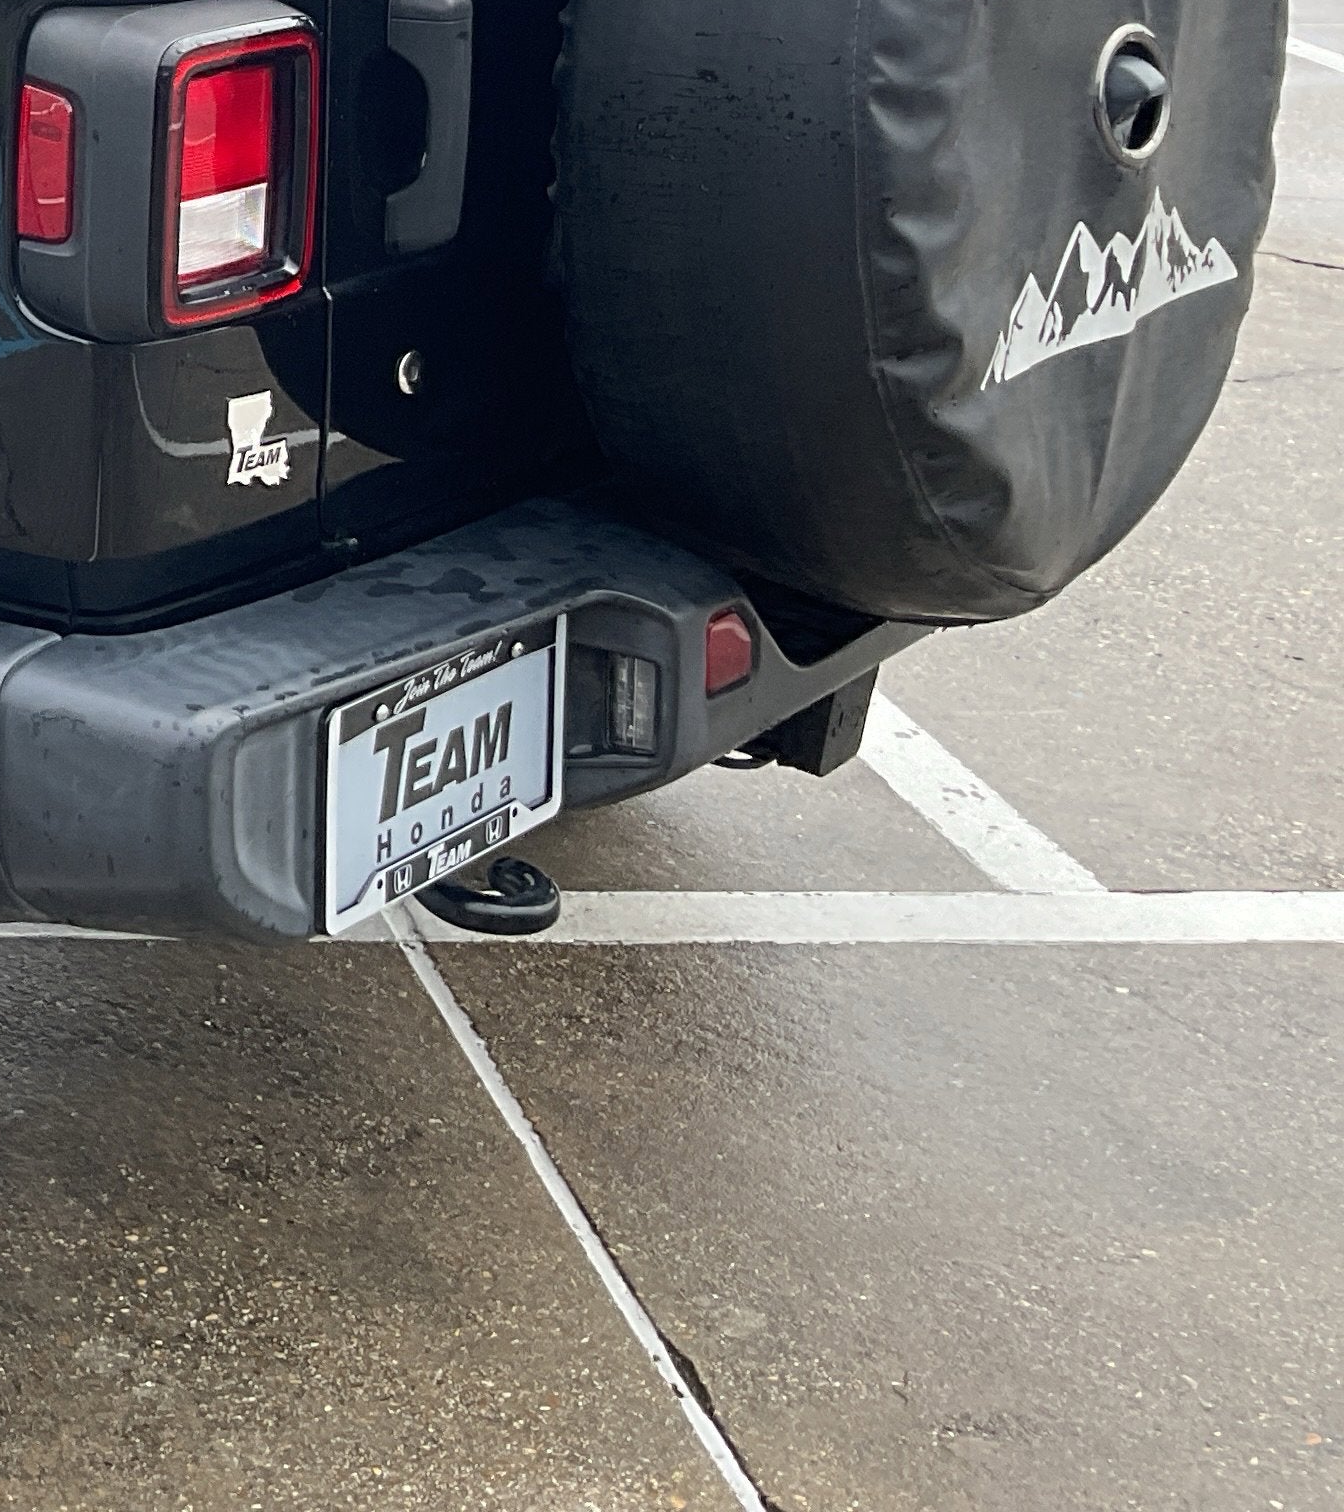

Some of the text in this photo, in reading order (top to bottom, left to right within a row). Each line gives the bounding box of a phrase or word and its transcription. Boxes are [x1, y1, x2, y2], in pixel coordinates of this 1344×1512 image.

[237, 445, 282, 474] TEAM
[393, 678, 431, 715] Join
[373, 701, 513, 825] TEAM
[377, 775, 512, 864] Honda
[427, 839, 472, 879] TEAM
